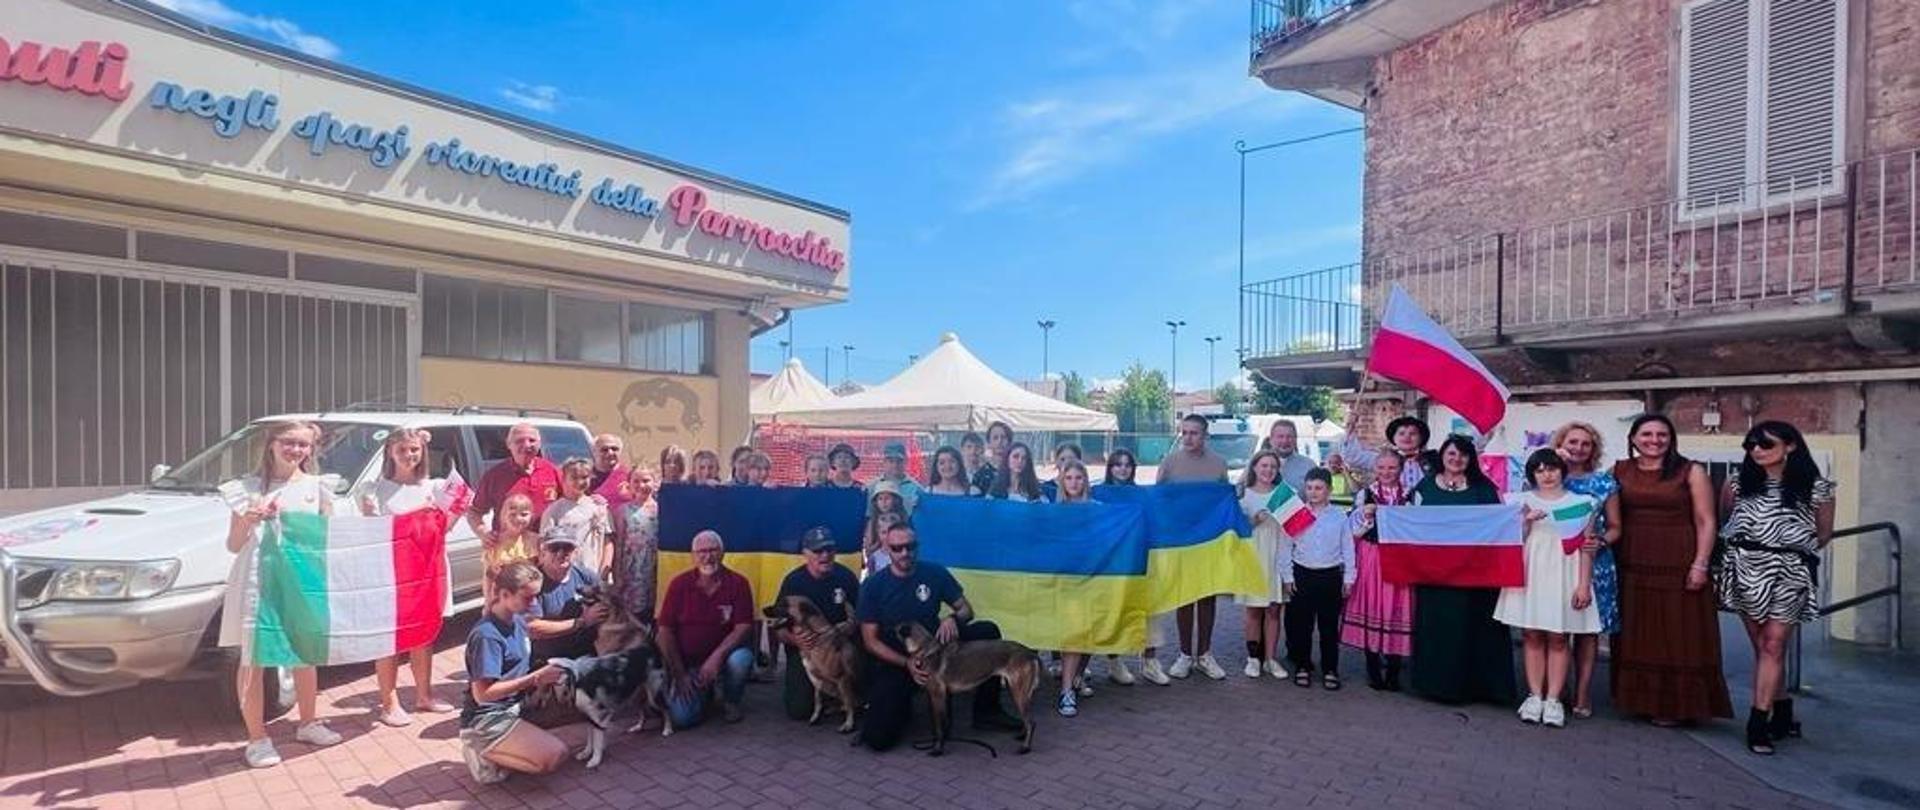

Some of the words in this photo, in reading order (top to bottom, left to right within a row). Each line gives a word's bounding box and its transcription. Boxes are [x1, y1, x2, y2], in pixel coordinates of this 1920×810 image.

[148, 81, 280, 137] negli
[291, 112, 411, 167] spazi
[425, 138, 582, 197] ricreativi
[591, 178, 660, 218] della
[669, 185, 844, 272] Parrocchia
